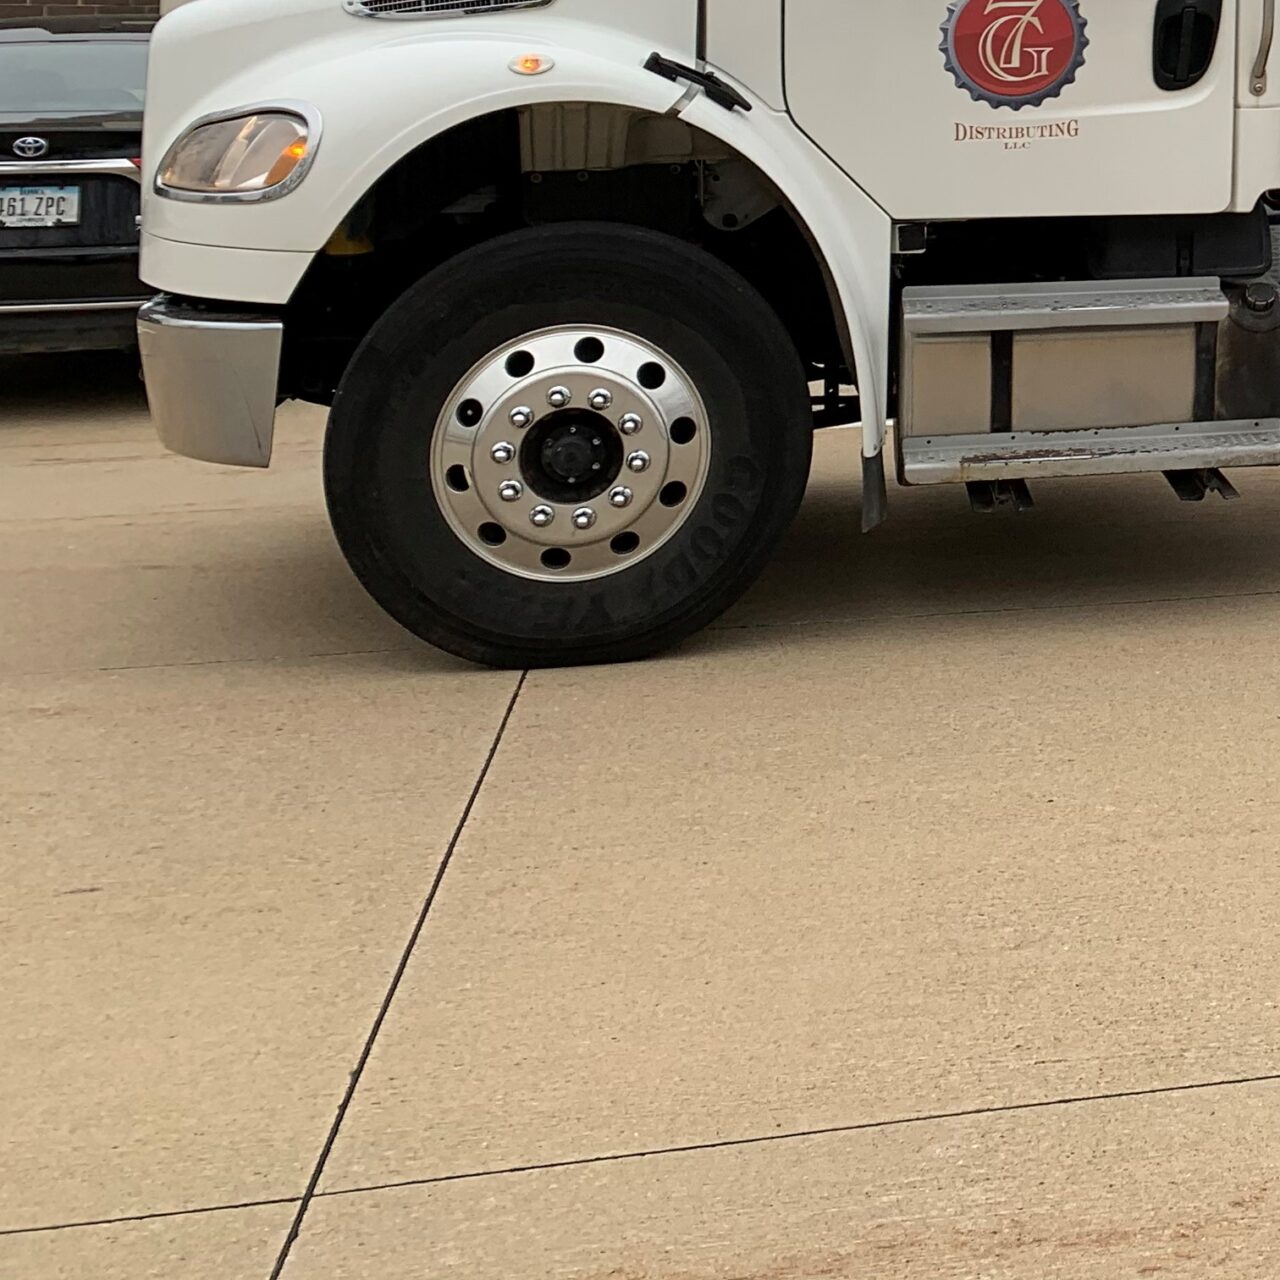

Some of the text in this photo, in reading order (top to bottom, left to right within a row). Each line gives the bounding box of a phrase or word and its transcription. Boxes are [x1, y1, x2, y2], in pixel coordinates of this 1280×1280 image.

[954, 119, 1079, 142] DISTRIBUTING
[1003, 142, 1031, 150] LLC
[34, 196, 66, 216] ZPC
